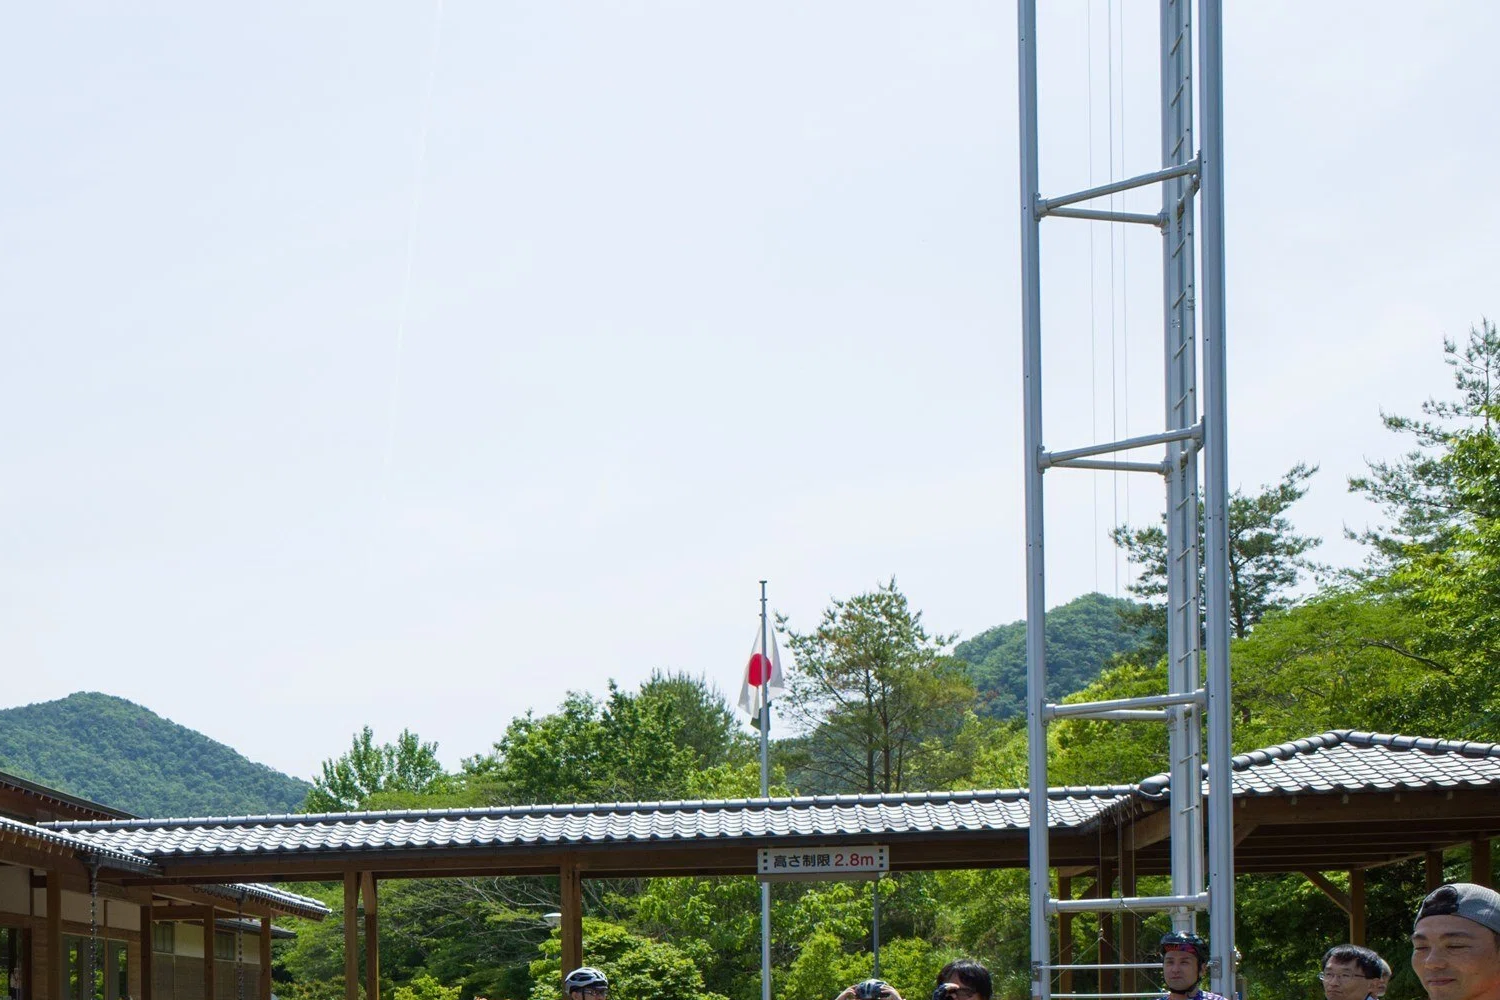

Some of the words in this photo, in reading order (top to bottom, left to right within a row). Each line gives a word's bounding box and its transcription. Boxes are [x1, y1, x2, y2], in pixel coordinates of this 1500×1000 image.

[773, 854, 830, 868] 高さ制限
[834, 853, 874, 867] 2.8m
